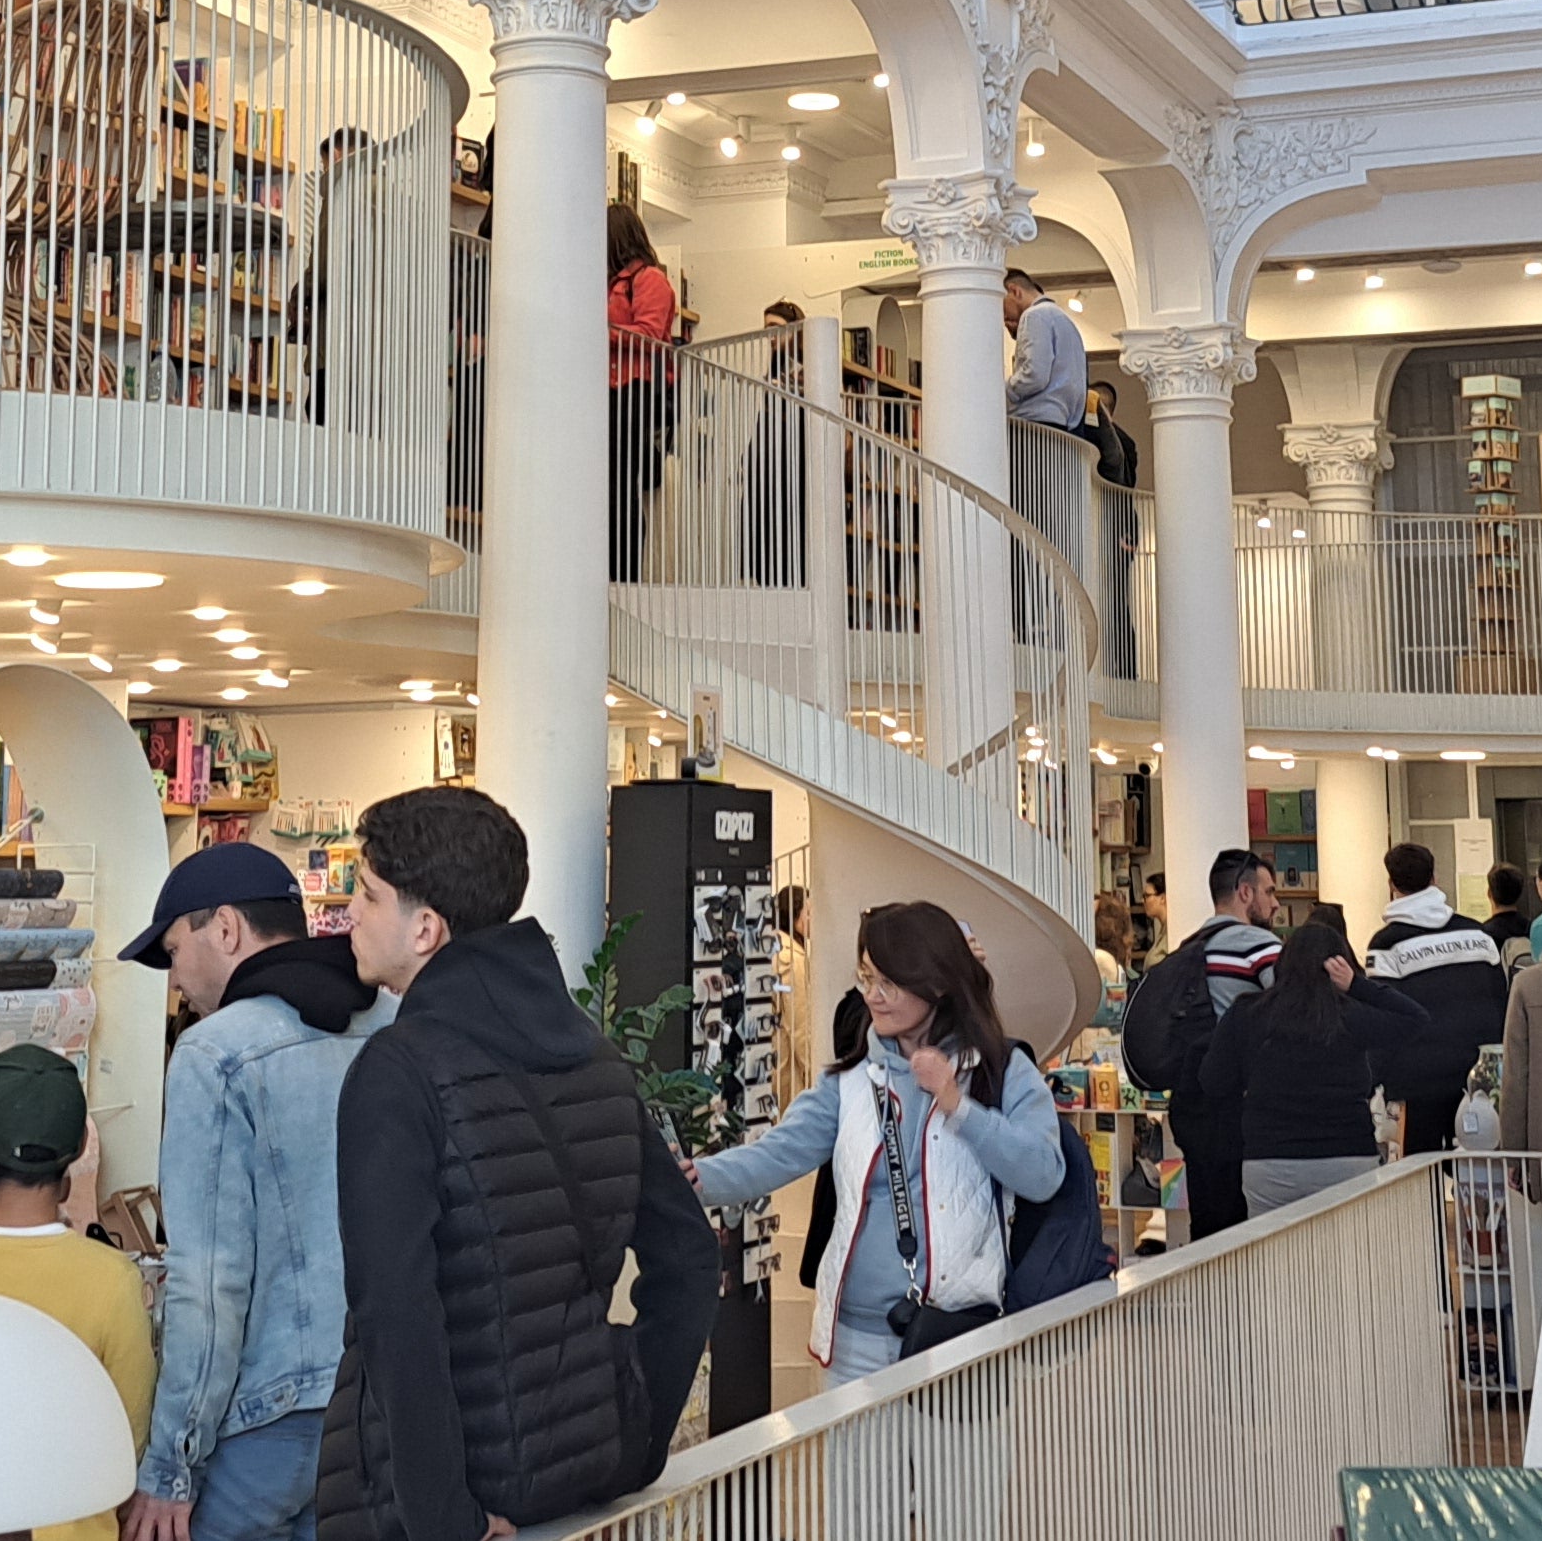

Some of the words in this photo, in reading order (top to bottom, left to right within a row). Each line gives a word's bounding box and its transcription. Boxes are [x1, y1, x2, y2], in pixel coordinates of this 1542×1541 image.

[859, 259, 892, 270] ENGLISH
[874, 249, 904, 259] FICTION
[1399, 944, 1436, 965] CALVIN
[1435, 940, 1463, 955] KLEIN
[885, 1119, 901, 1165] TOMMY
[891, 1170, 911, 1231] HILFIGER
